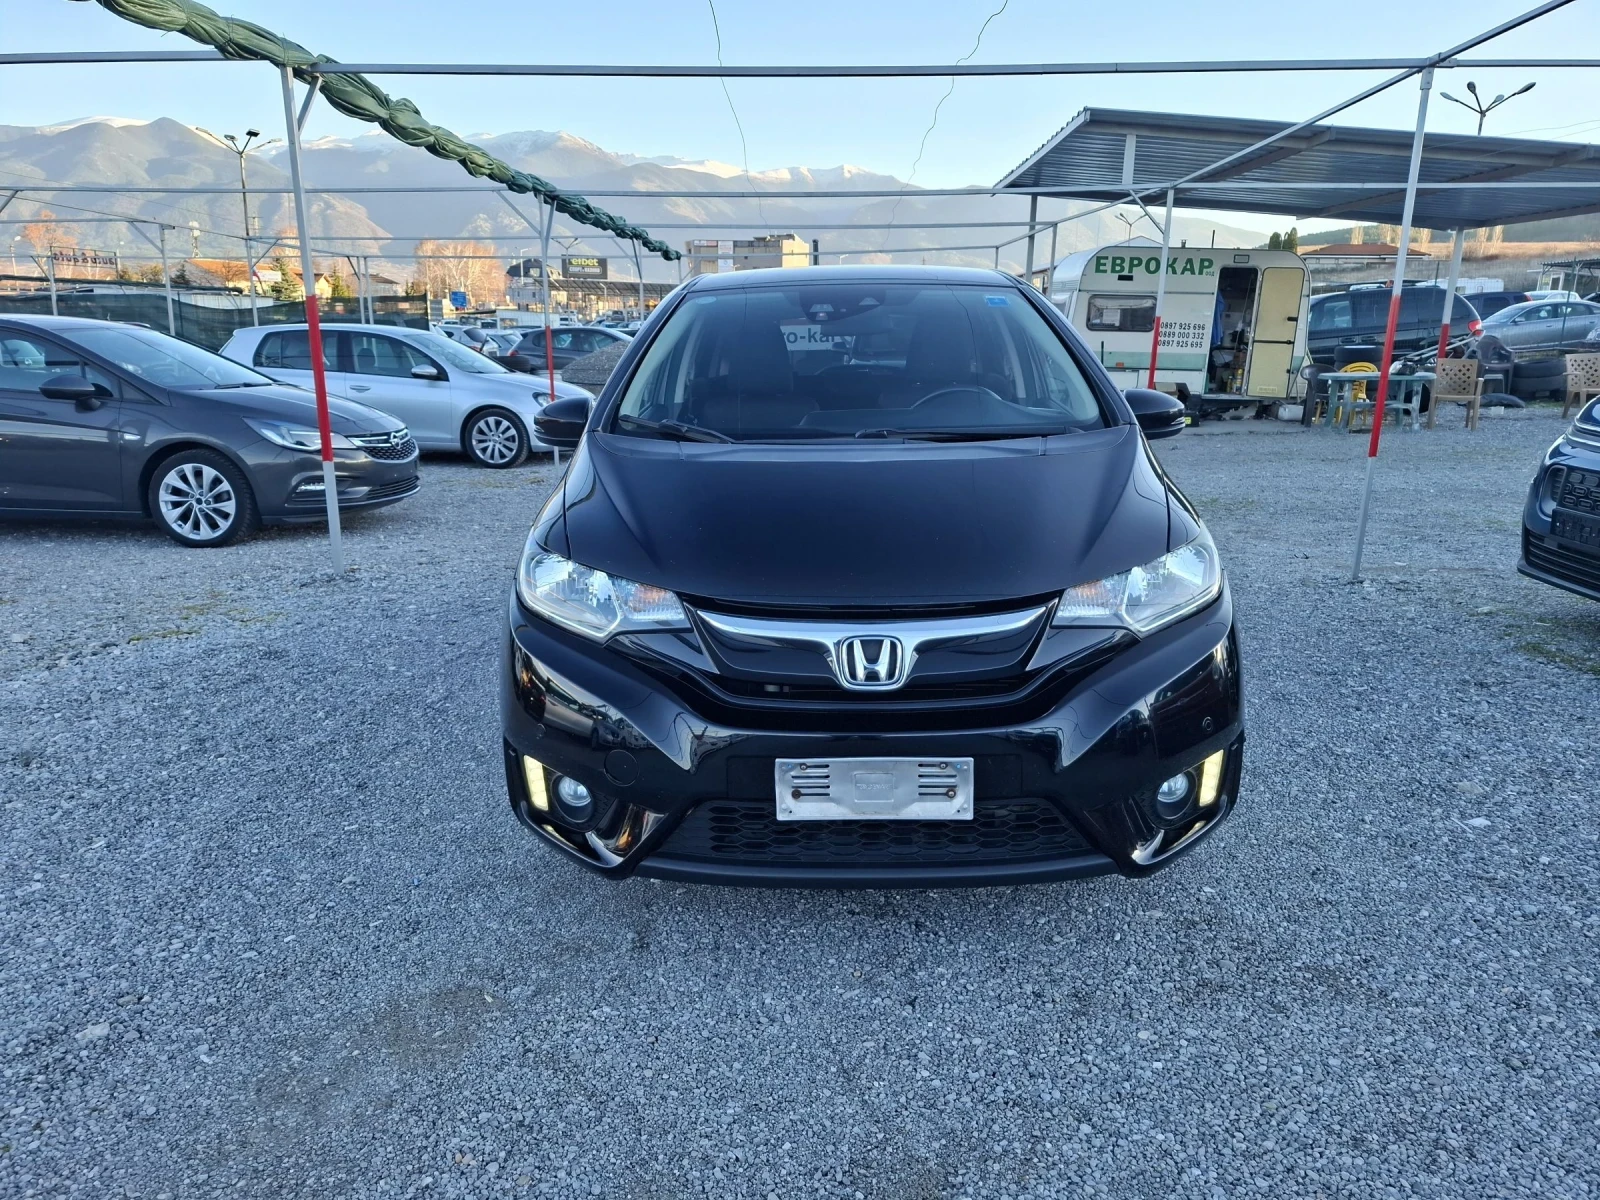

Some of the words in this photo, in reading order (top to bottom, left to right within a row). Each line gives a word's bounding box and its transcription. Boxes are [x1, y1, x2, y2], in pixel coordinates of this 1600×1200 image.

[1095, 256, 1213, 275] ЕВРОКАР
[1160, 321, 1178, 330] 0897
[1178, 322, 1191, 330] 925
[1192, 323, 1206, 331] 696
[1158, 330, 1176, 339] 0889
[1177, 331, 1190, 339] 000
[1191, 332, 1205, 340] 332
[1157, 339, 1175, 347] 0897
[1175, 340, 1189, 348] 925
[1190, 341, 1203, 349] 695
